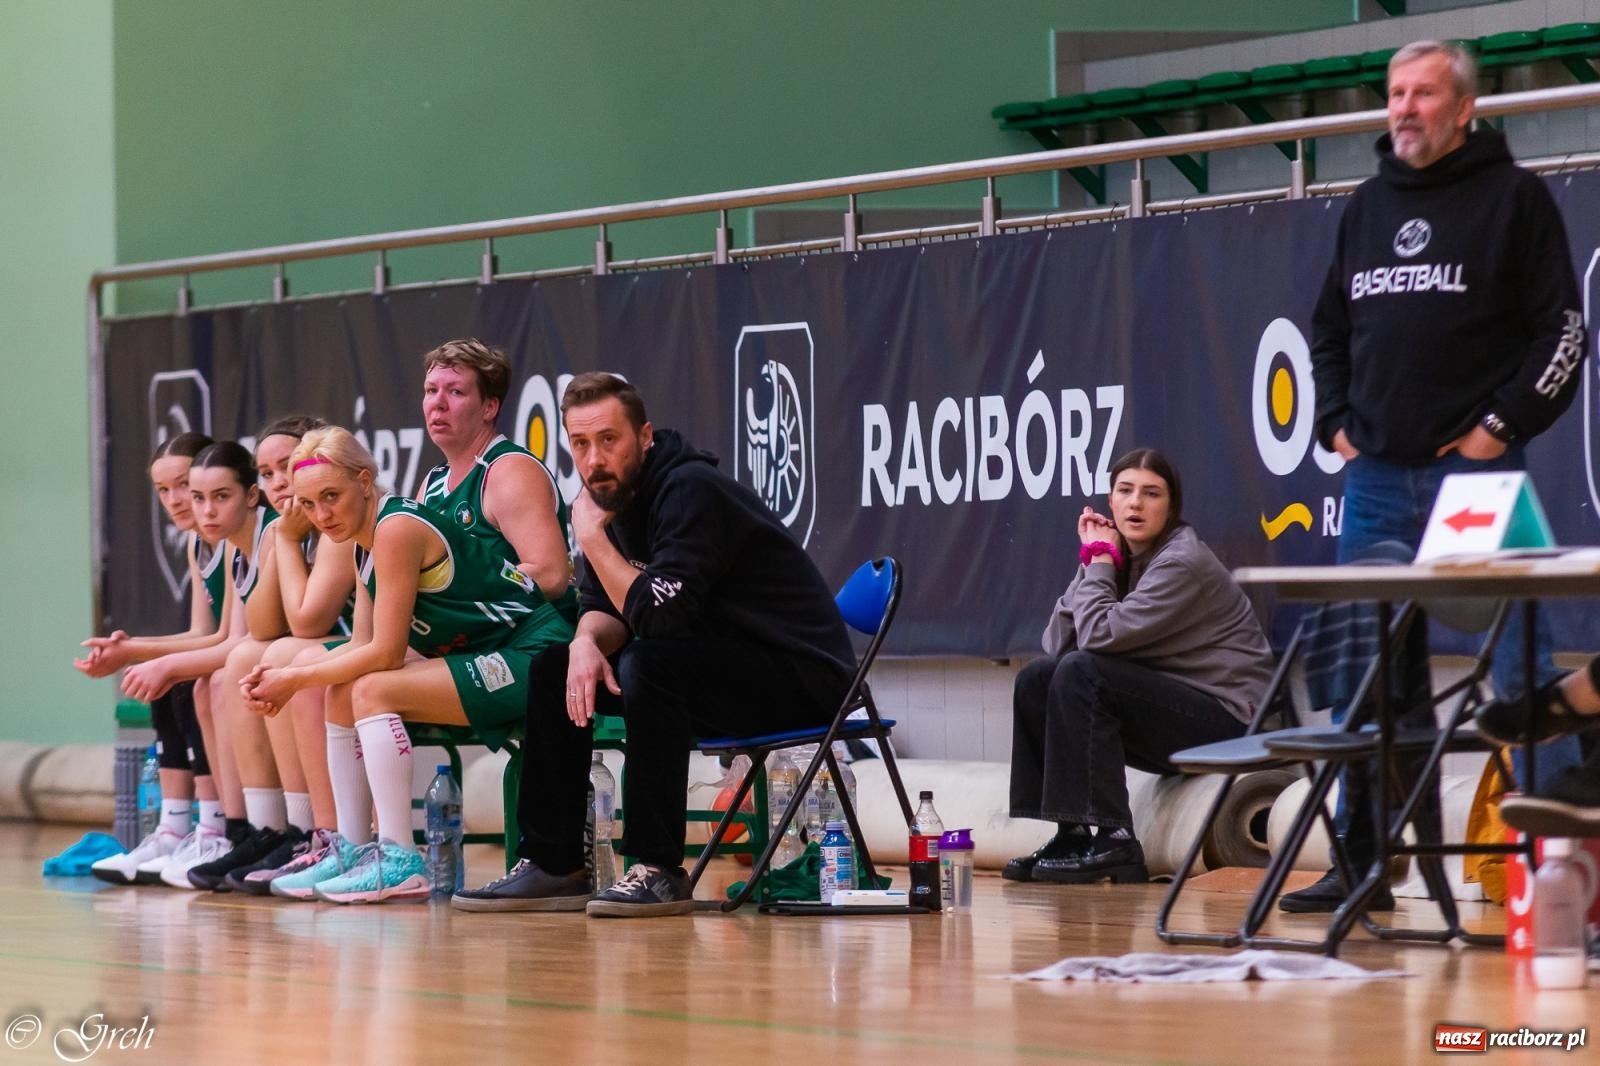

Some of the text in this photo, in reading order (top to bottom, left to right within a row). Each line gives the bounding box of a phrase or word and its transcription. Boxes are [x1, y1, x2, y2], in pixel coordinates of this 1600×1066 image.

[1351, 263, 1468, 300] BASKETBALL
[1535, 309, 1583, 400] PREZES
[862, 348, 1126, 508] RACIBÓRZ
[388, 717, 411, 756] ALLSIX
